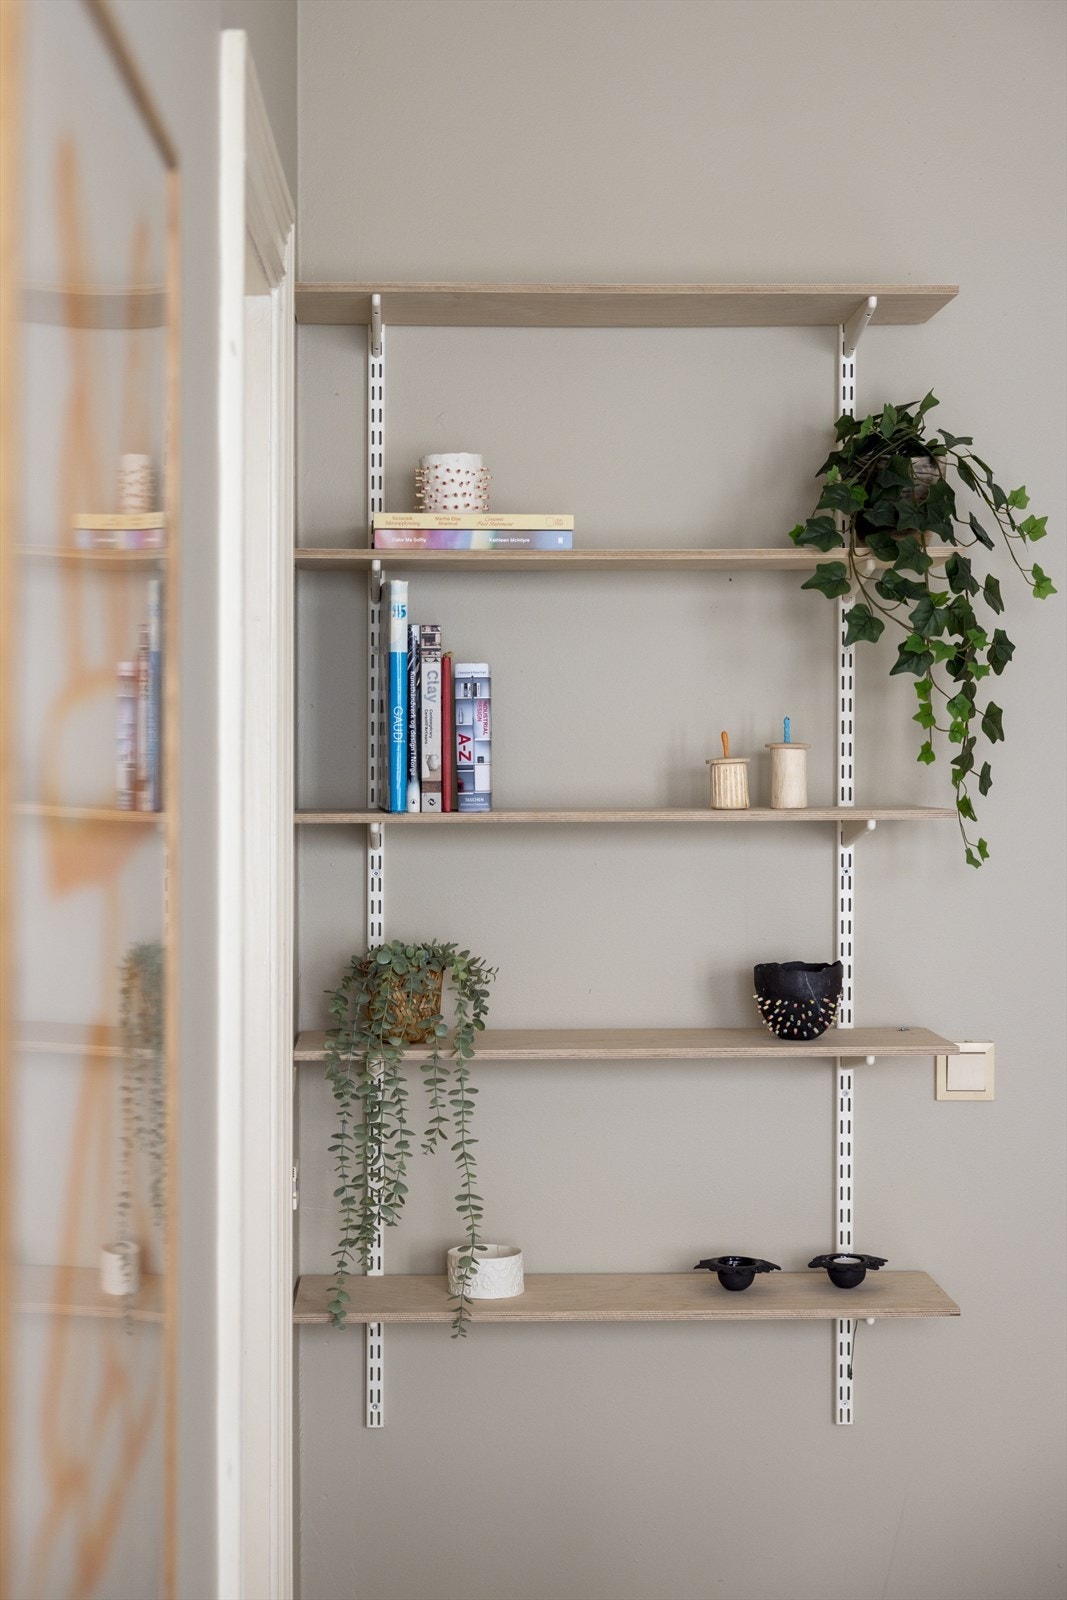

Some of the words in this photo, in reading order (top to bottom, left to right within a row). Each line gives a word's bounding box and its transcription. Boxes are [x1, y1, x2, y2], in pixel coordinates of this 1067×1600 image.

[424, 670, 439, 703] Clay
[393, 705, 405, 743] GAUDÍ
[409, 720, 416, 729] og
[458, 734, 472, 762] A-Z
